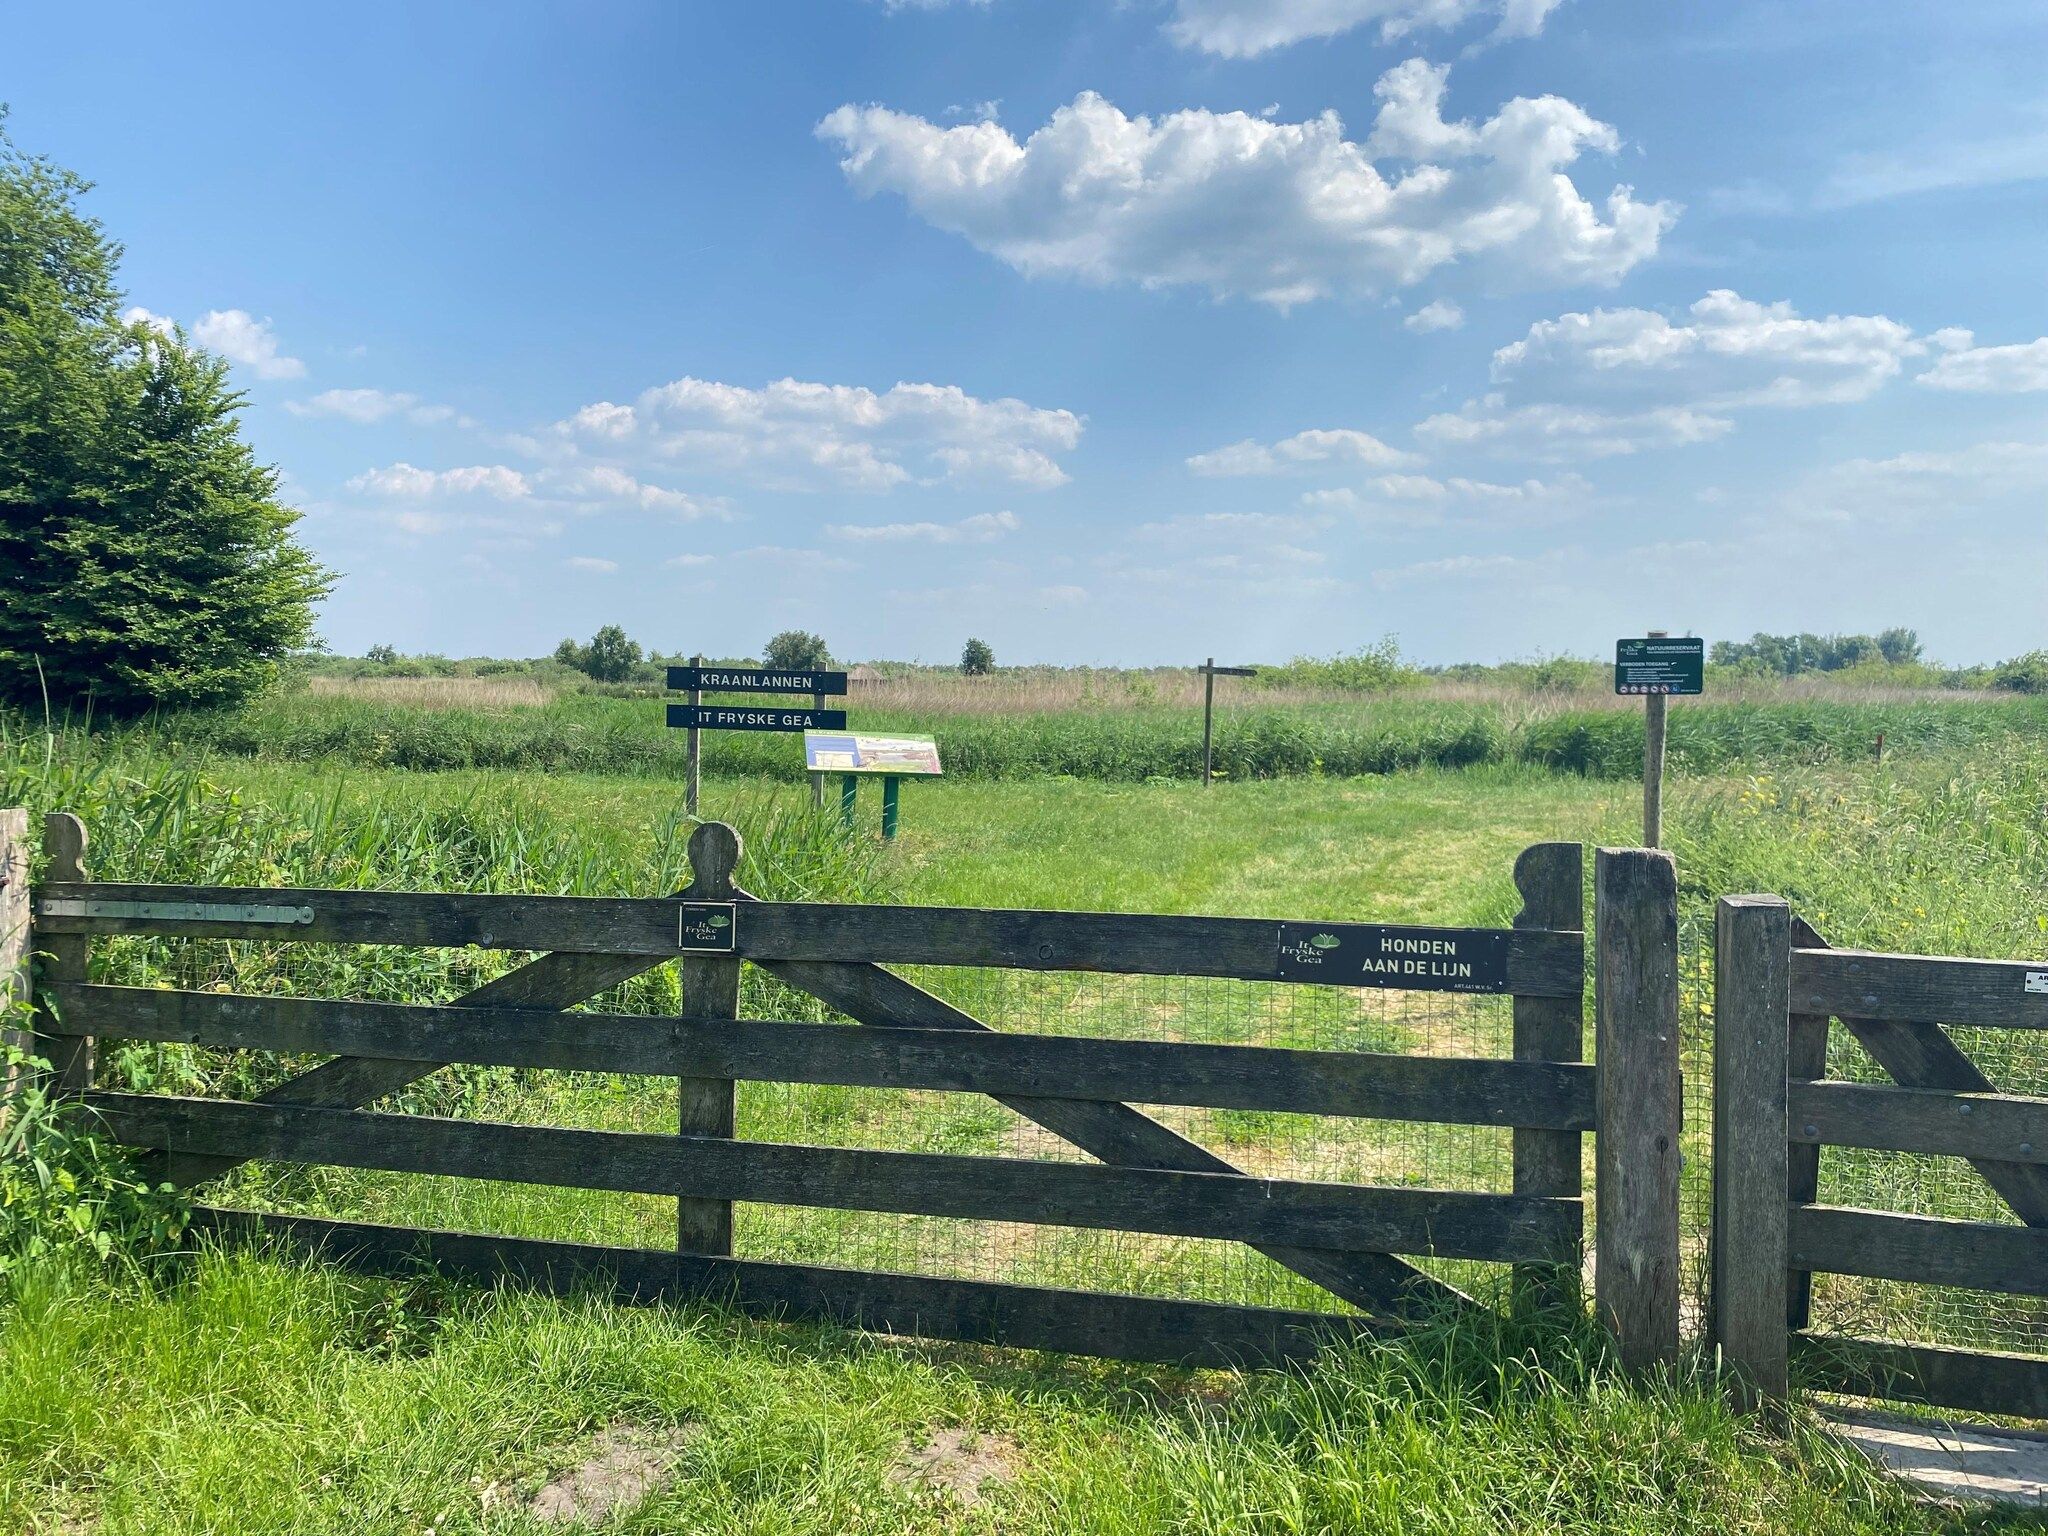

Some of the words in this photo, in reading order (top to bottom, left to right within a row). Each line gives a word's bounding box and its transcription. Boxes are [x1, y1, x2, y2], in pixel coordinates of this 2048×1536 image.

[700, 673, 813, 688] KRAANLANNEN
[698, 712, 711, 723] IT
[718, 712, 776, 726] FRYSKE
[782, 715, 813, 727] GEA
[686, 926, 718, 934] Fryske
[1299, 940, 1308, 948] It
[1381, 938, 1456, 956] HONDEN
[1282, 946, 1324, 956] Fryske
[1296, 954, 1322, 964] Gea
[1362, 958, 1400, 974] AAN
[1404, 960, 1427, 975] DE
[1432, 962, 1472, 978] LIJN
